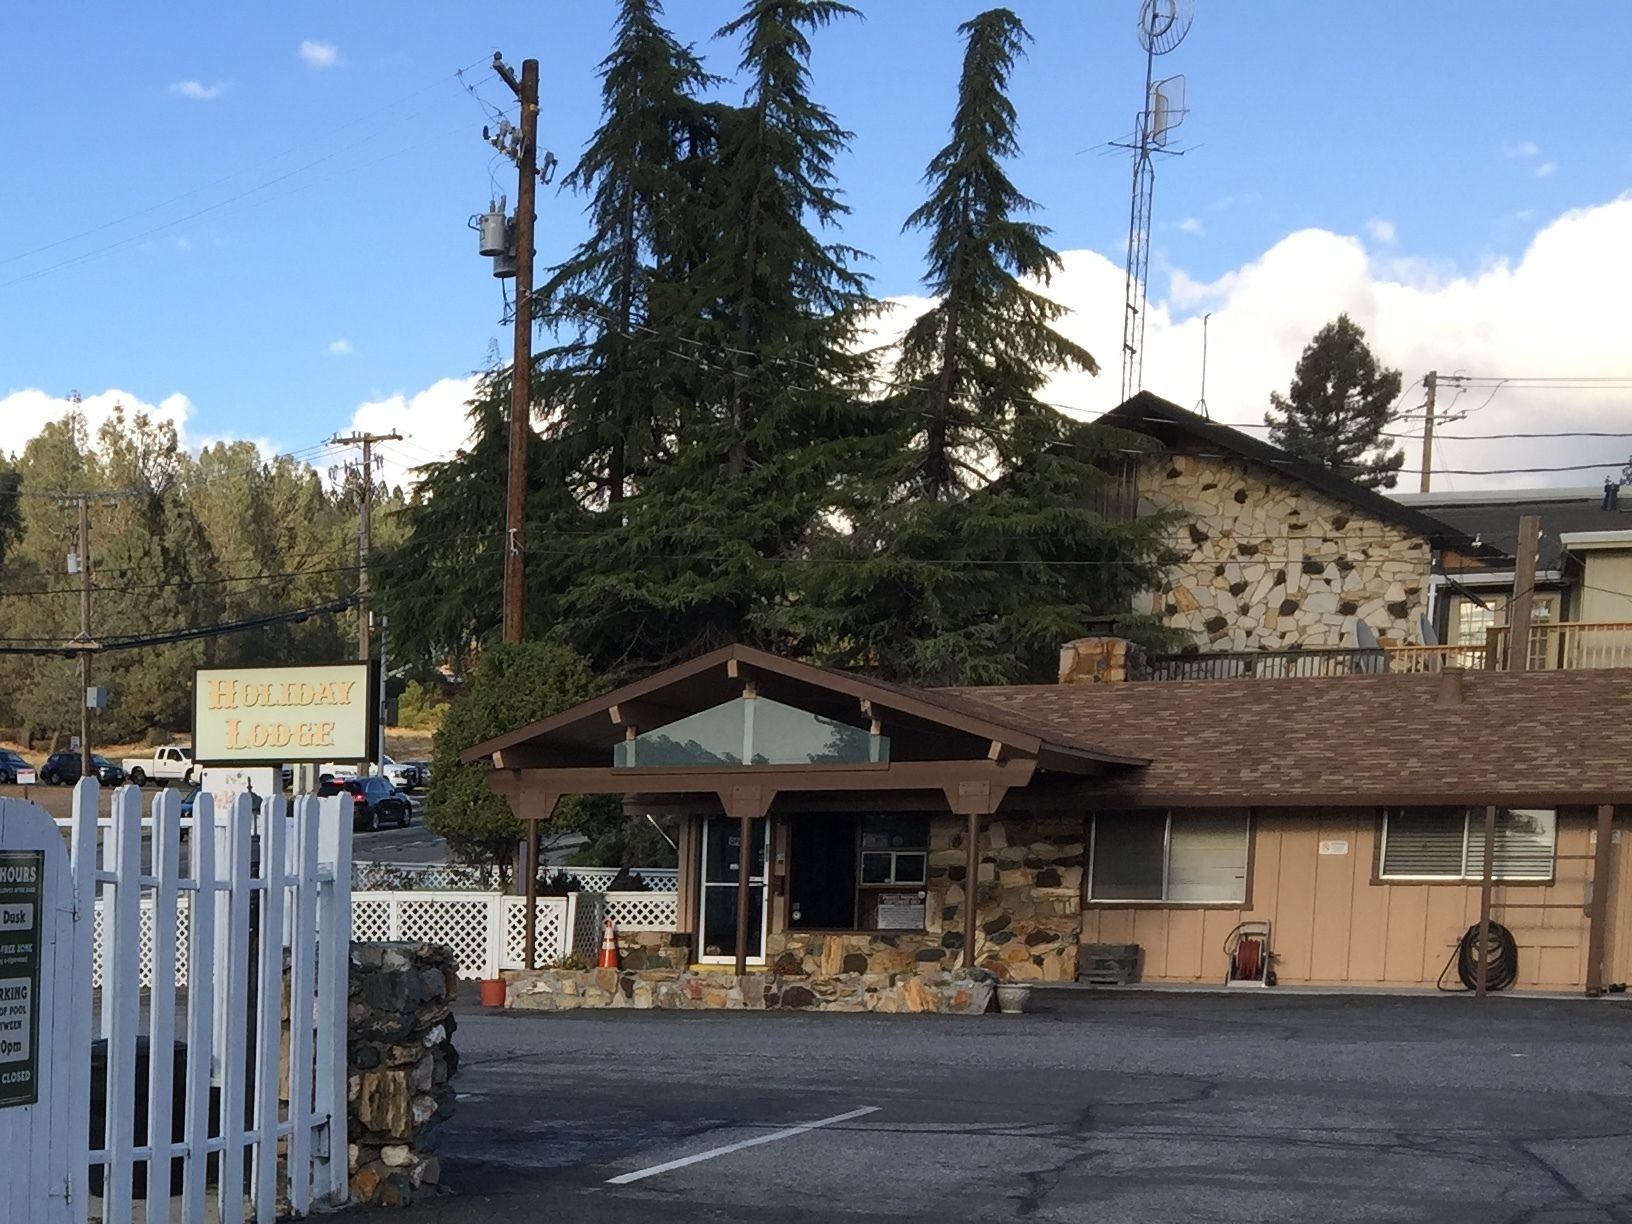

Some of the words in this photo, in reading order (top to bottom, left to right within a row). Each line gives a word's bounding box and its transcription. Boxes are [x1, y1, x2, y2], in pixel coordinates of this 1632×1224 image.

[208, 679, 355, 710] HOLIDAY
[225, 719, 336, 750] LODGE
[3, 909, 26, 924] Dusk
[9, 1005, 27, 1015] POOL
[1, 1070, 31, 1084] CLOSED
